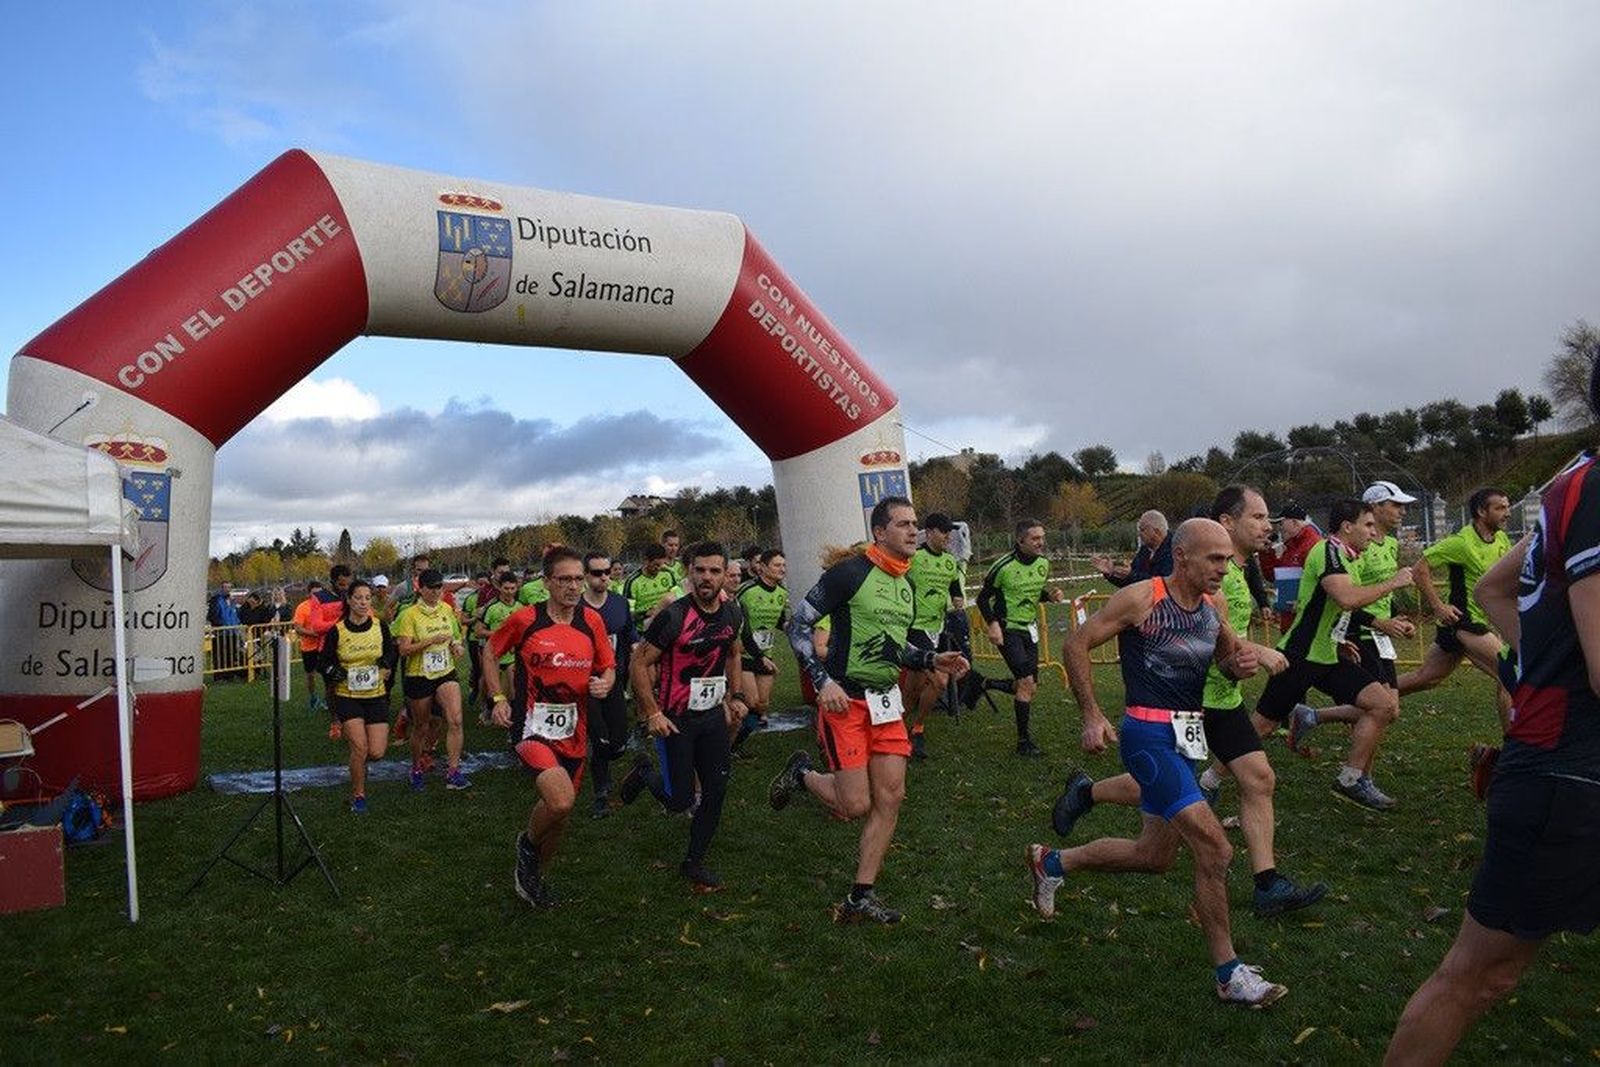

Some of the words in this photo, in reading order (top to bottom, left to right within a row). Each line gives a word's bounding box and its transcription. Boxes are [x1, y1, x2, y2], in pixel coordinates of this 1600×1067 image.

[517, 216, 652, 253] Diputación
[117, 333, 186, 389] CON
[181, 308, 226, 341] EL
[220, 213, 343, 312] DEPORTE
[515, 274, 539, 295] de
[548, 271, 675, 306] Salamanca
[757, 273, 796, 316] CON
[796, 314, 881, 408] NUESTROS
[748, 299, 862, 421] DEPORTISTAS
[21, 654, 43, 676] de
[55, 648, 195, 678] Salanca
[431, 654, 443, 664] 70
[356, 672, 370, 683] 69
[700, 686, 715, 699] 41
[881, 695, 891, 709] 6
[544, 713, 567, 727] 40
